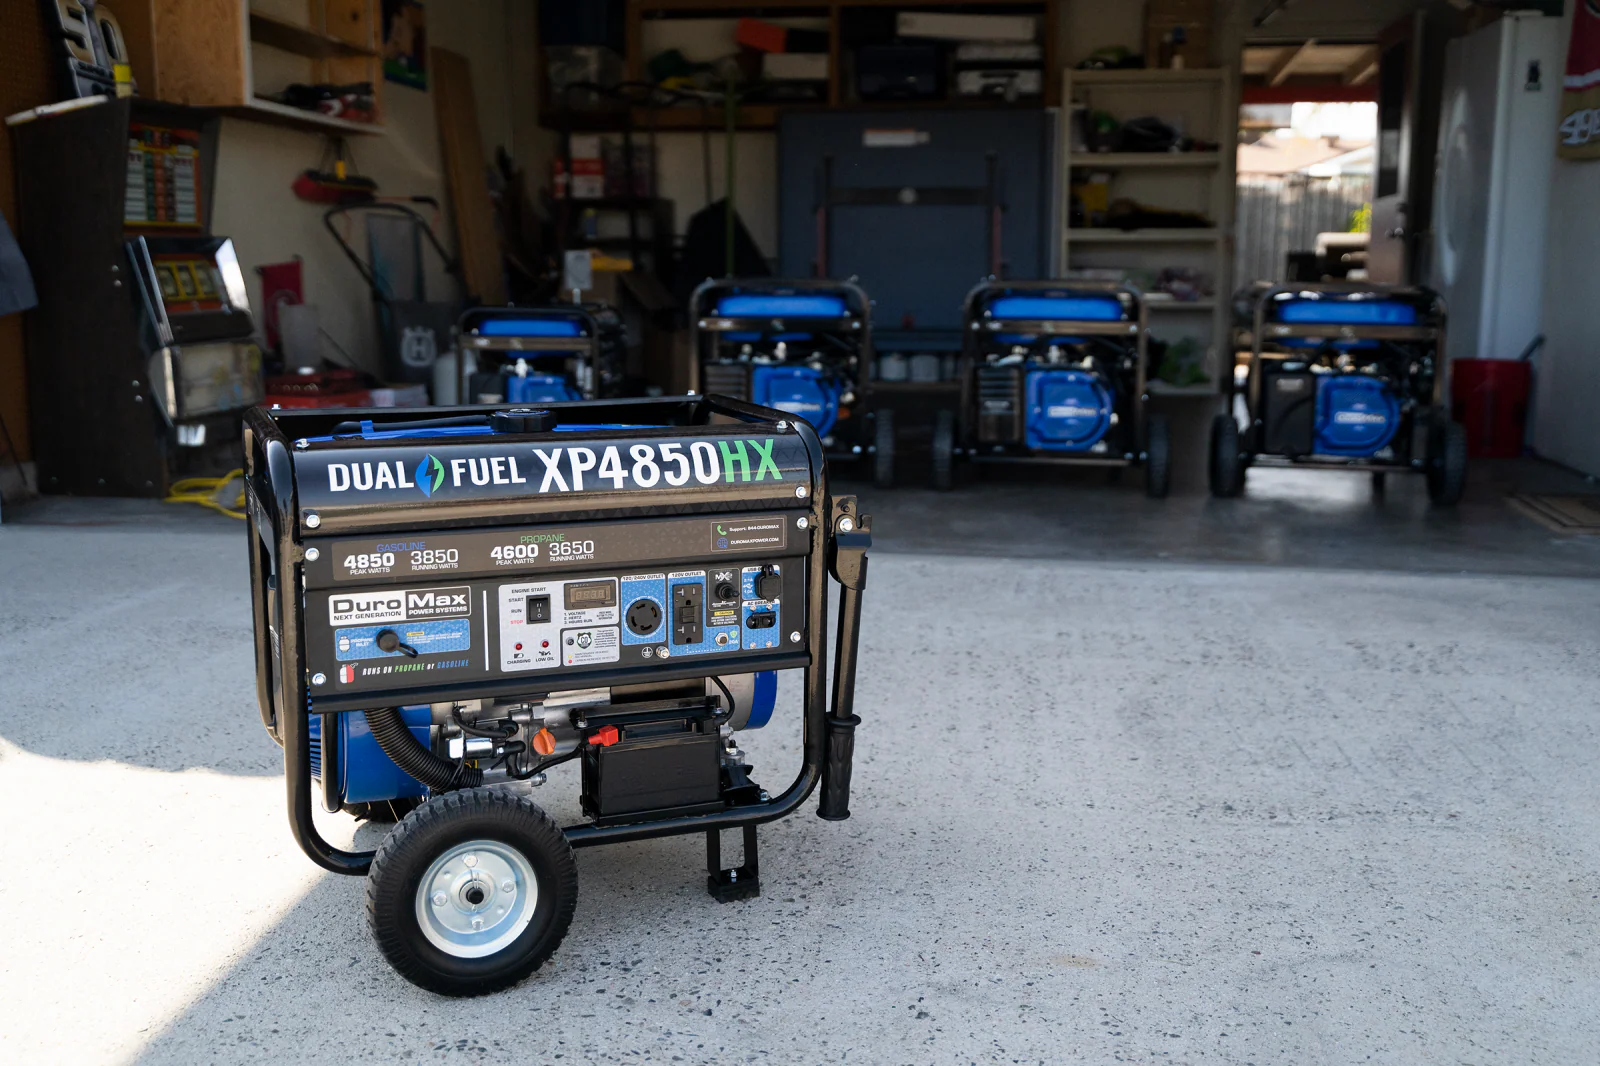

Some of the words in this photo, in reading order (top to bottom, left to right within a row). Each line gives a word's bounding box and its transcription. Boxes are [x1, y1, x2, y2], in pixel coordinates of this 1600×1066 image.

[327, 461, 415, 492] DUAL
[450, 456, 526, 487] FUEL
[532, 438, 782, 493] XP4850HX
[376, 541, 426, 552] GASOLINE
[520, 533, 565, 544] PROPANE
[490, 544, 539, 560] 4600
[549, 540, 595, 556] 3650
[344, 552, 395, 569] 4850
[410, 549, 459, 565] 3850
[333, 598, 401, 614] Duro
[408, 592, 467, 609] Max
[408, 608, 434, 616] POWER
[435, 605, 468, 614] SYSTEMS
[355, 611, 401, 620] GENERATION
[362, 666, 381, 676] RUNS
[383, 665, 393, 674] ON
[394, 663, 425, 673] PROPANE
[436, 659, 469, 669] GASOLINE
